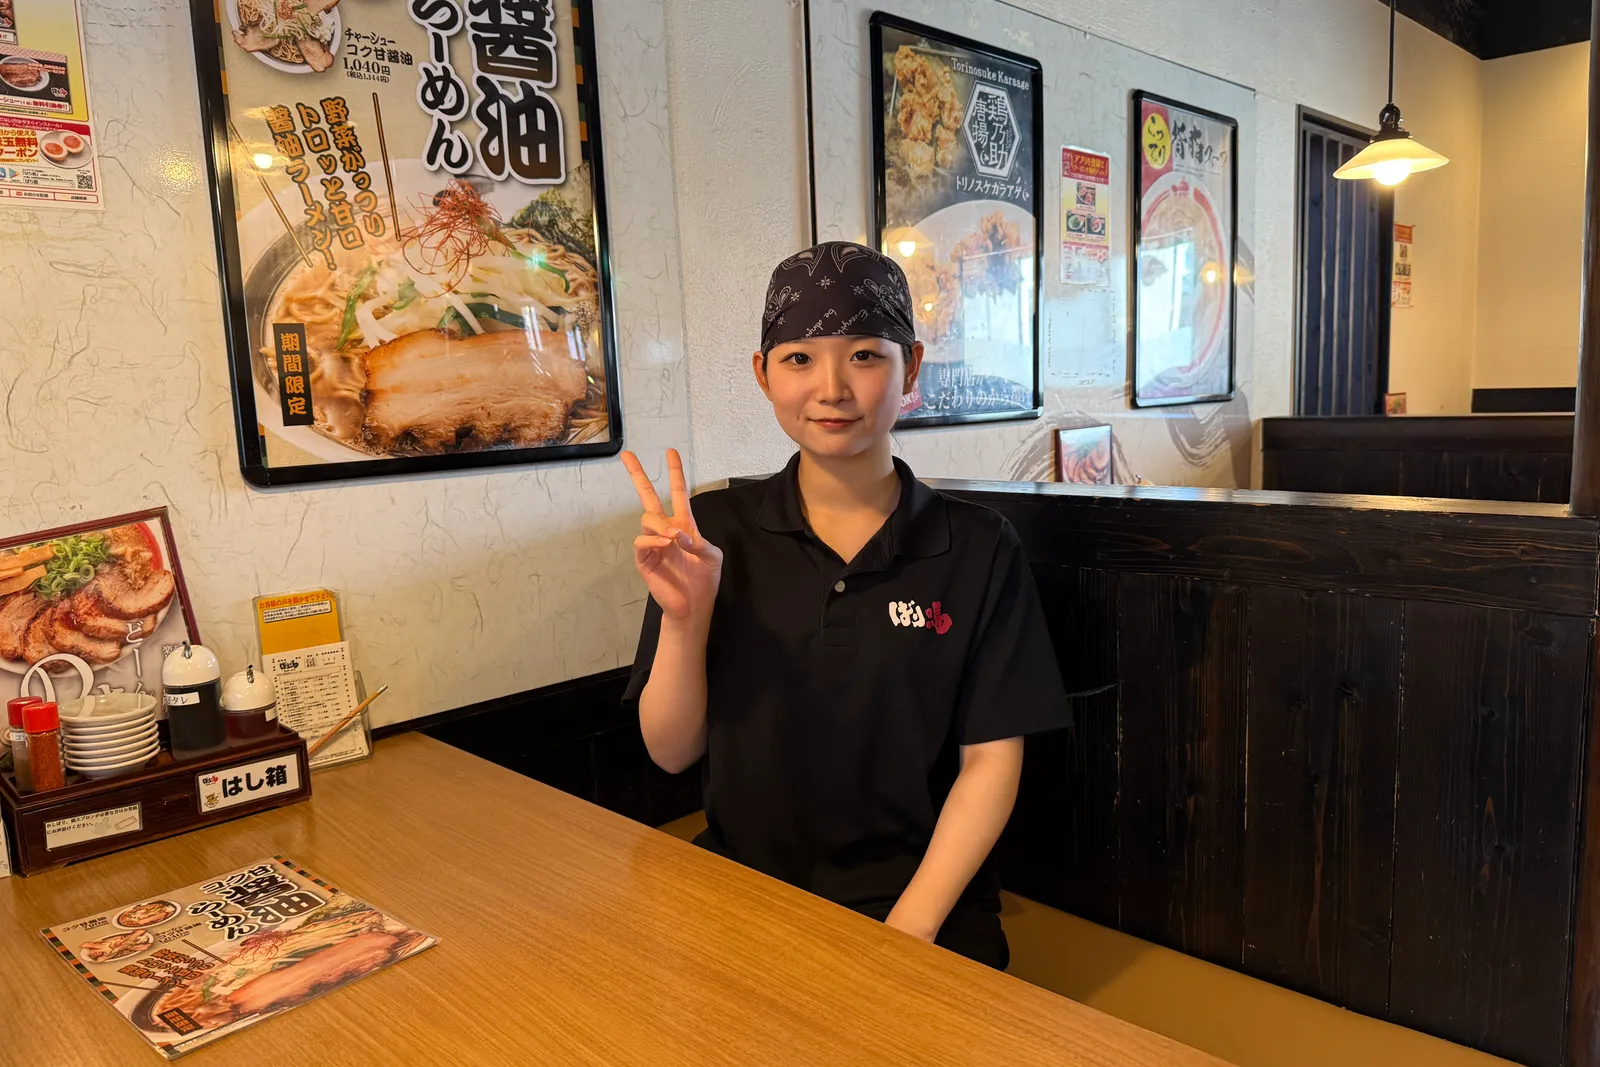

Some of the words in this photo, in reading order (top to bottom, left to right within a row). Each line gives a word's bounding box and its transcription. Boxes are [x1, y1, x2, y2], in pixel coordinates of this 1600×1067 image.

[344, 27, 396, 46] チャーシュー
[345, 43, 414, 66] コク甘醤油
[950, 57, 997, 82] Torinosuke
[997, 71, 1030, 91] Karaage
[0, 136, 38, 148] 玉無料
[296, 103, 364, 251] トロッと甘口
[321, 97, 386, 239] 野菜がっつり
[956, 175, 1024, 200] トリノスケカラアゲ
[280, 331, 308, 416] 期間限定
[222, 765, 288, 799] はし箱
[202, 864, 272, 893] コク甘
[220, 874, 326, 922] 醤油
[189, 898, 258, 940] らーめん
